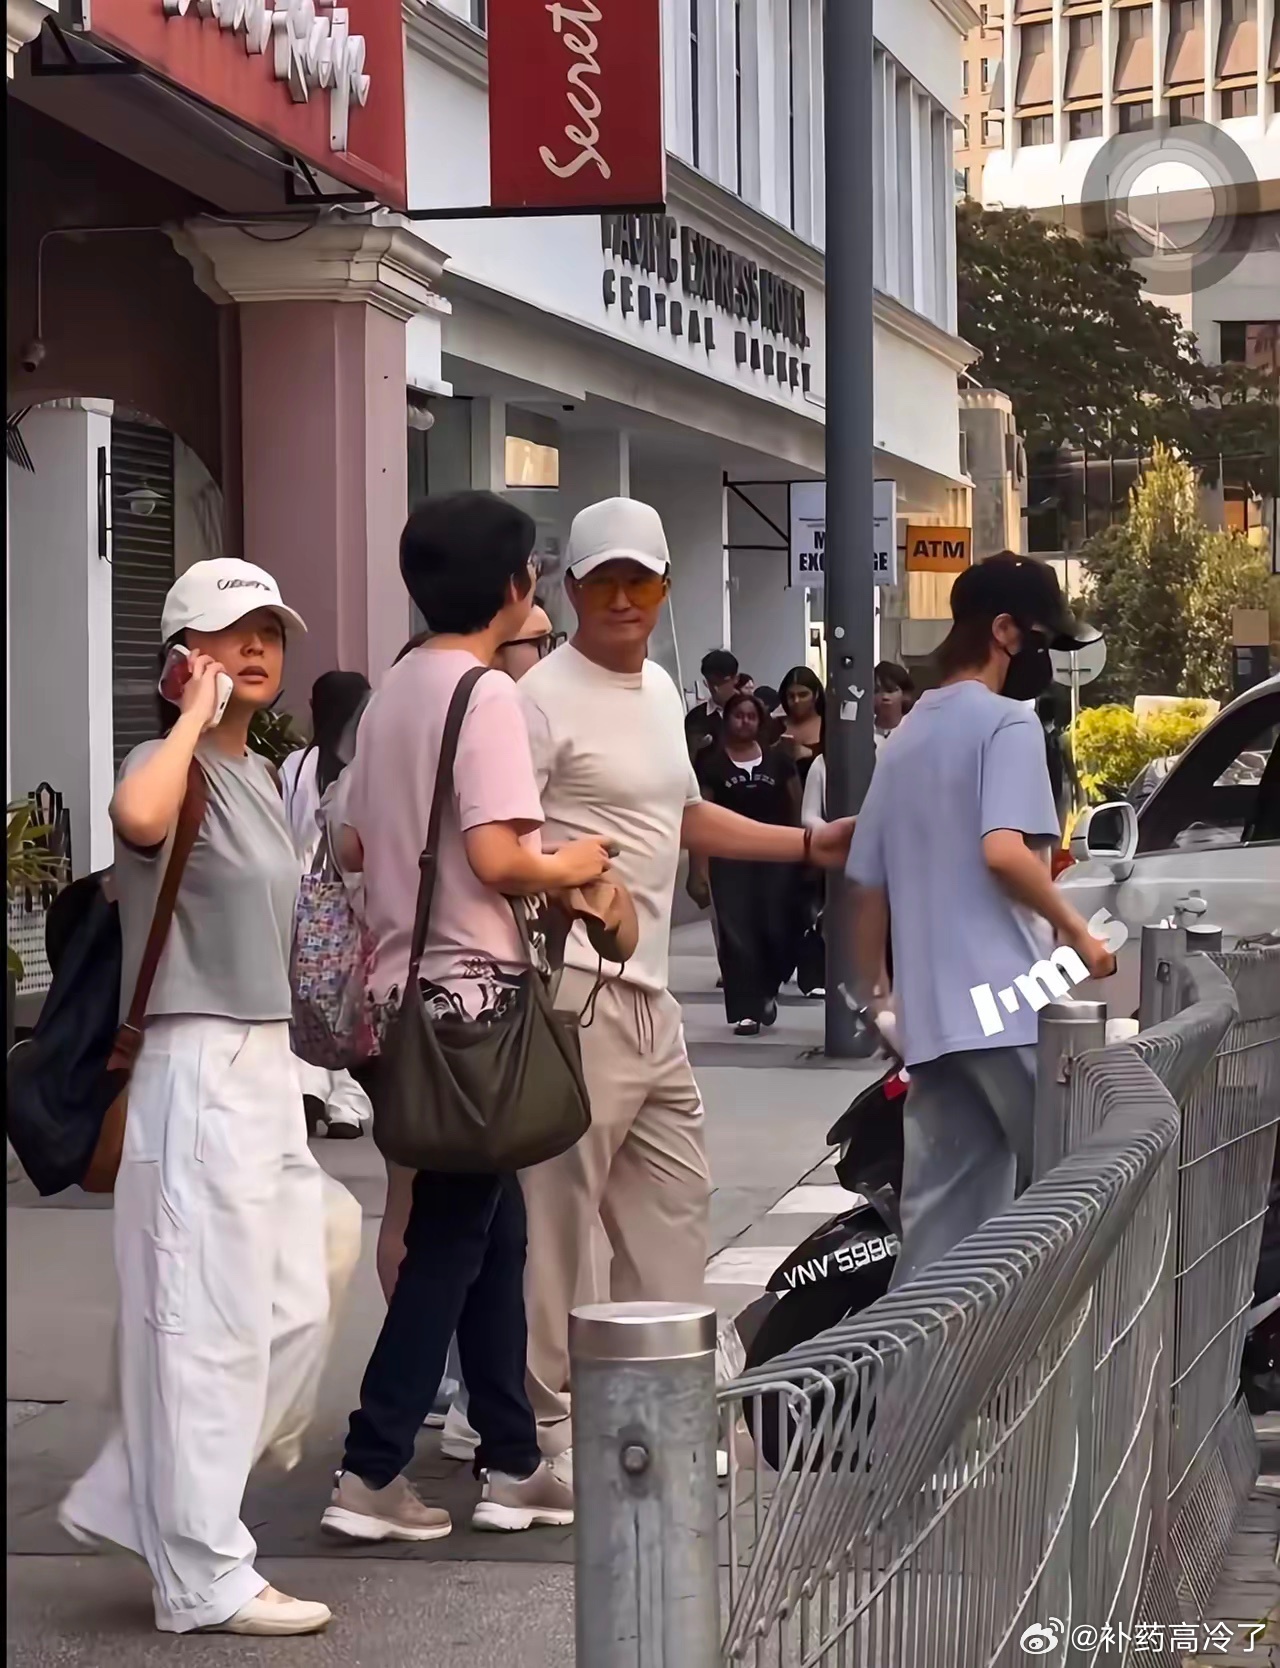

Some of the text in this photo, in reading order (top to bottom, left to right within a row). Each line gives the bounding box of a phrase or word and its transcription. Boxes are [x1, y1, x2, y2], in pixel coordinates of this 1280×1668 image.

[539, 0, 611, 179] Secret
[602, 268, 810, 392] CENTRAL MARKET
[681, 226, 759, 322] EXPRESS
[759, 268, 810, 350] HOTEL
[913, 540, 965, 560] ATM
[784, 1254, 829, 1288] VNV
